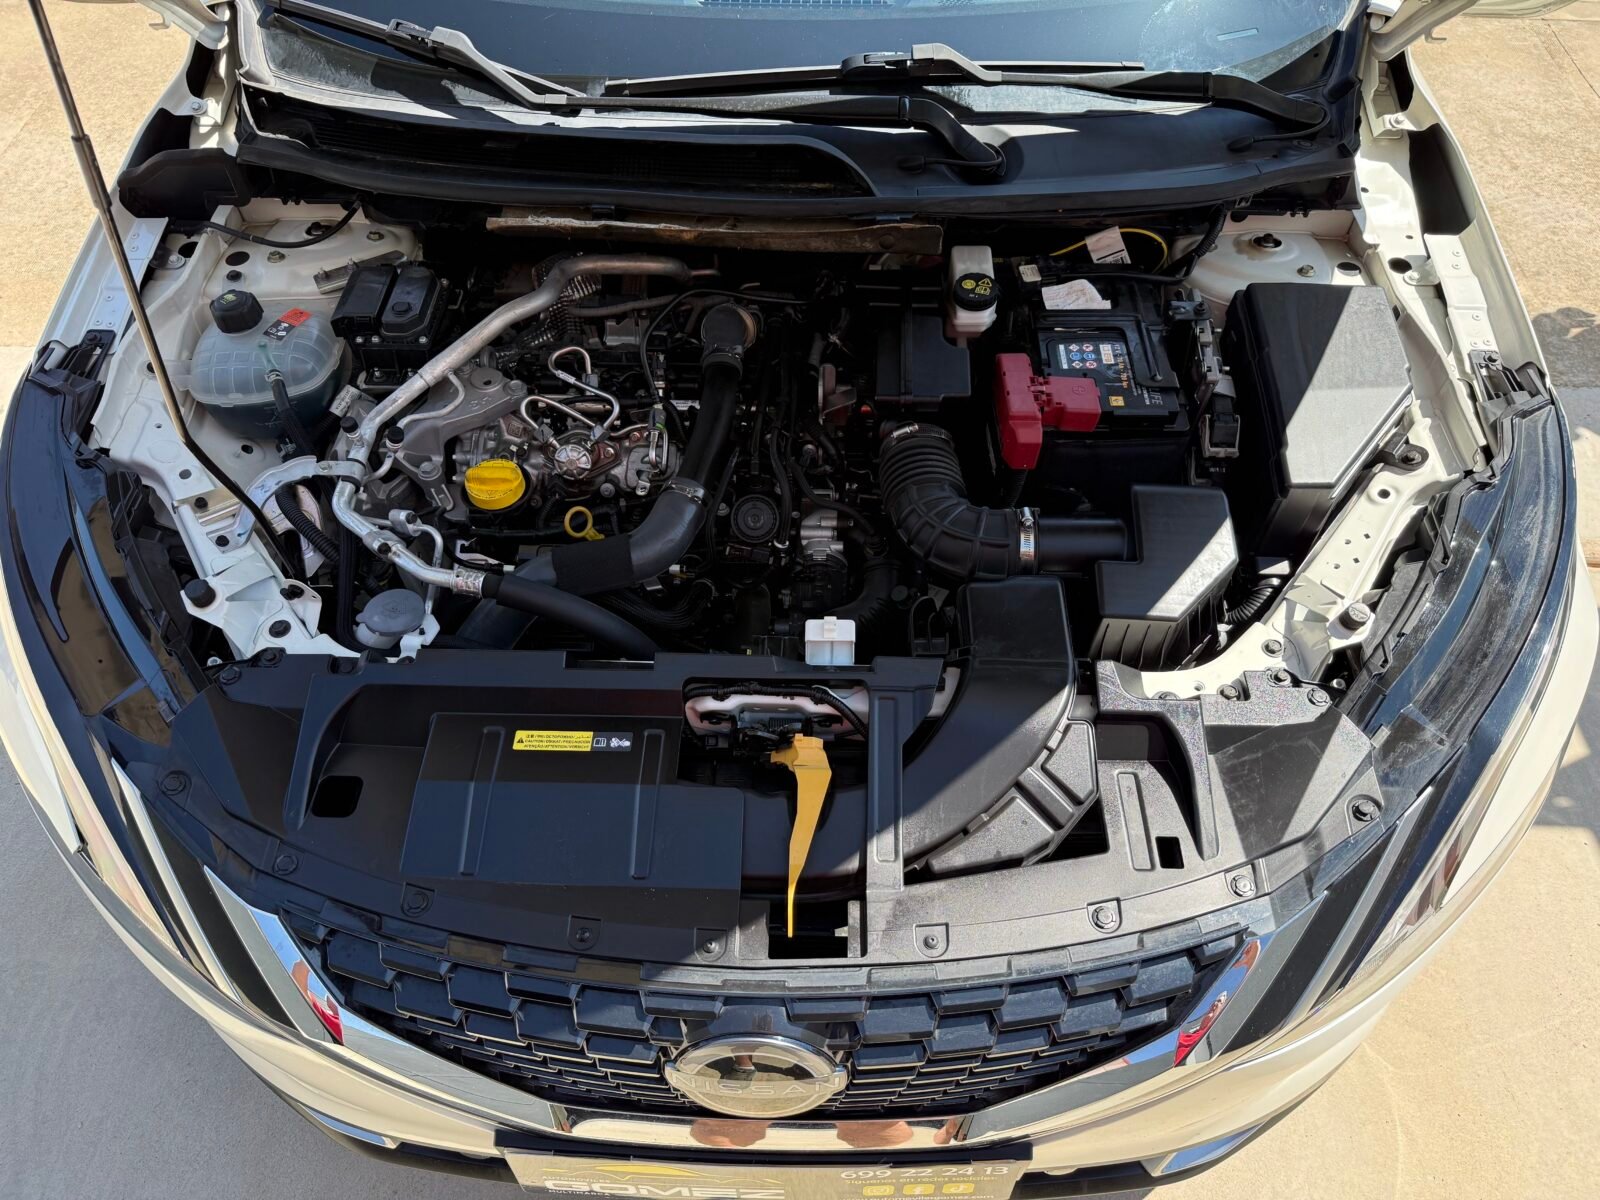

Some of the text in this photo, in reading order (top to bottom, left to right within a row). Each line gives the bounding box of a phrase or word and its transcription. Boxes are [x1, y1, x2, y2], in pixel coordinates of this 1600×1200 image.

[672, 1073, 840, 1095] NISSAN
[841, 1166, 1009, 1179] 699 22 24 13
[542, 1176, 610, 1184] AUTOMOVILES
[544, 1180, 785, 1199] GOMEZ
[548, 1189, 611, 1197] MULTIMARCA
